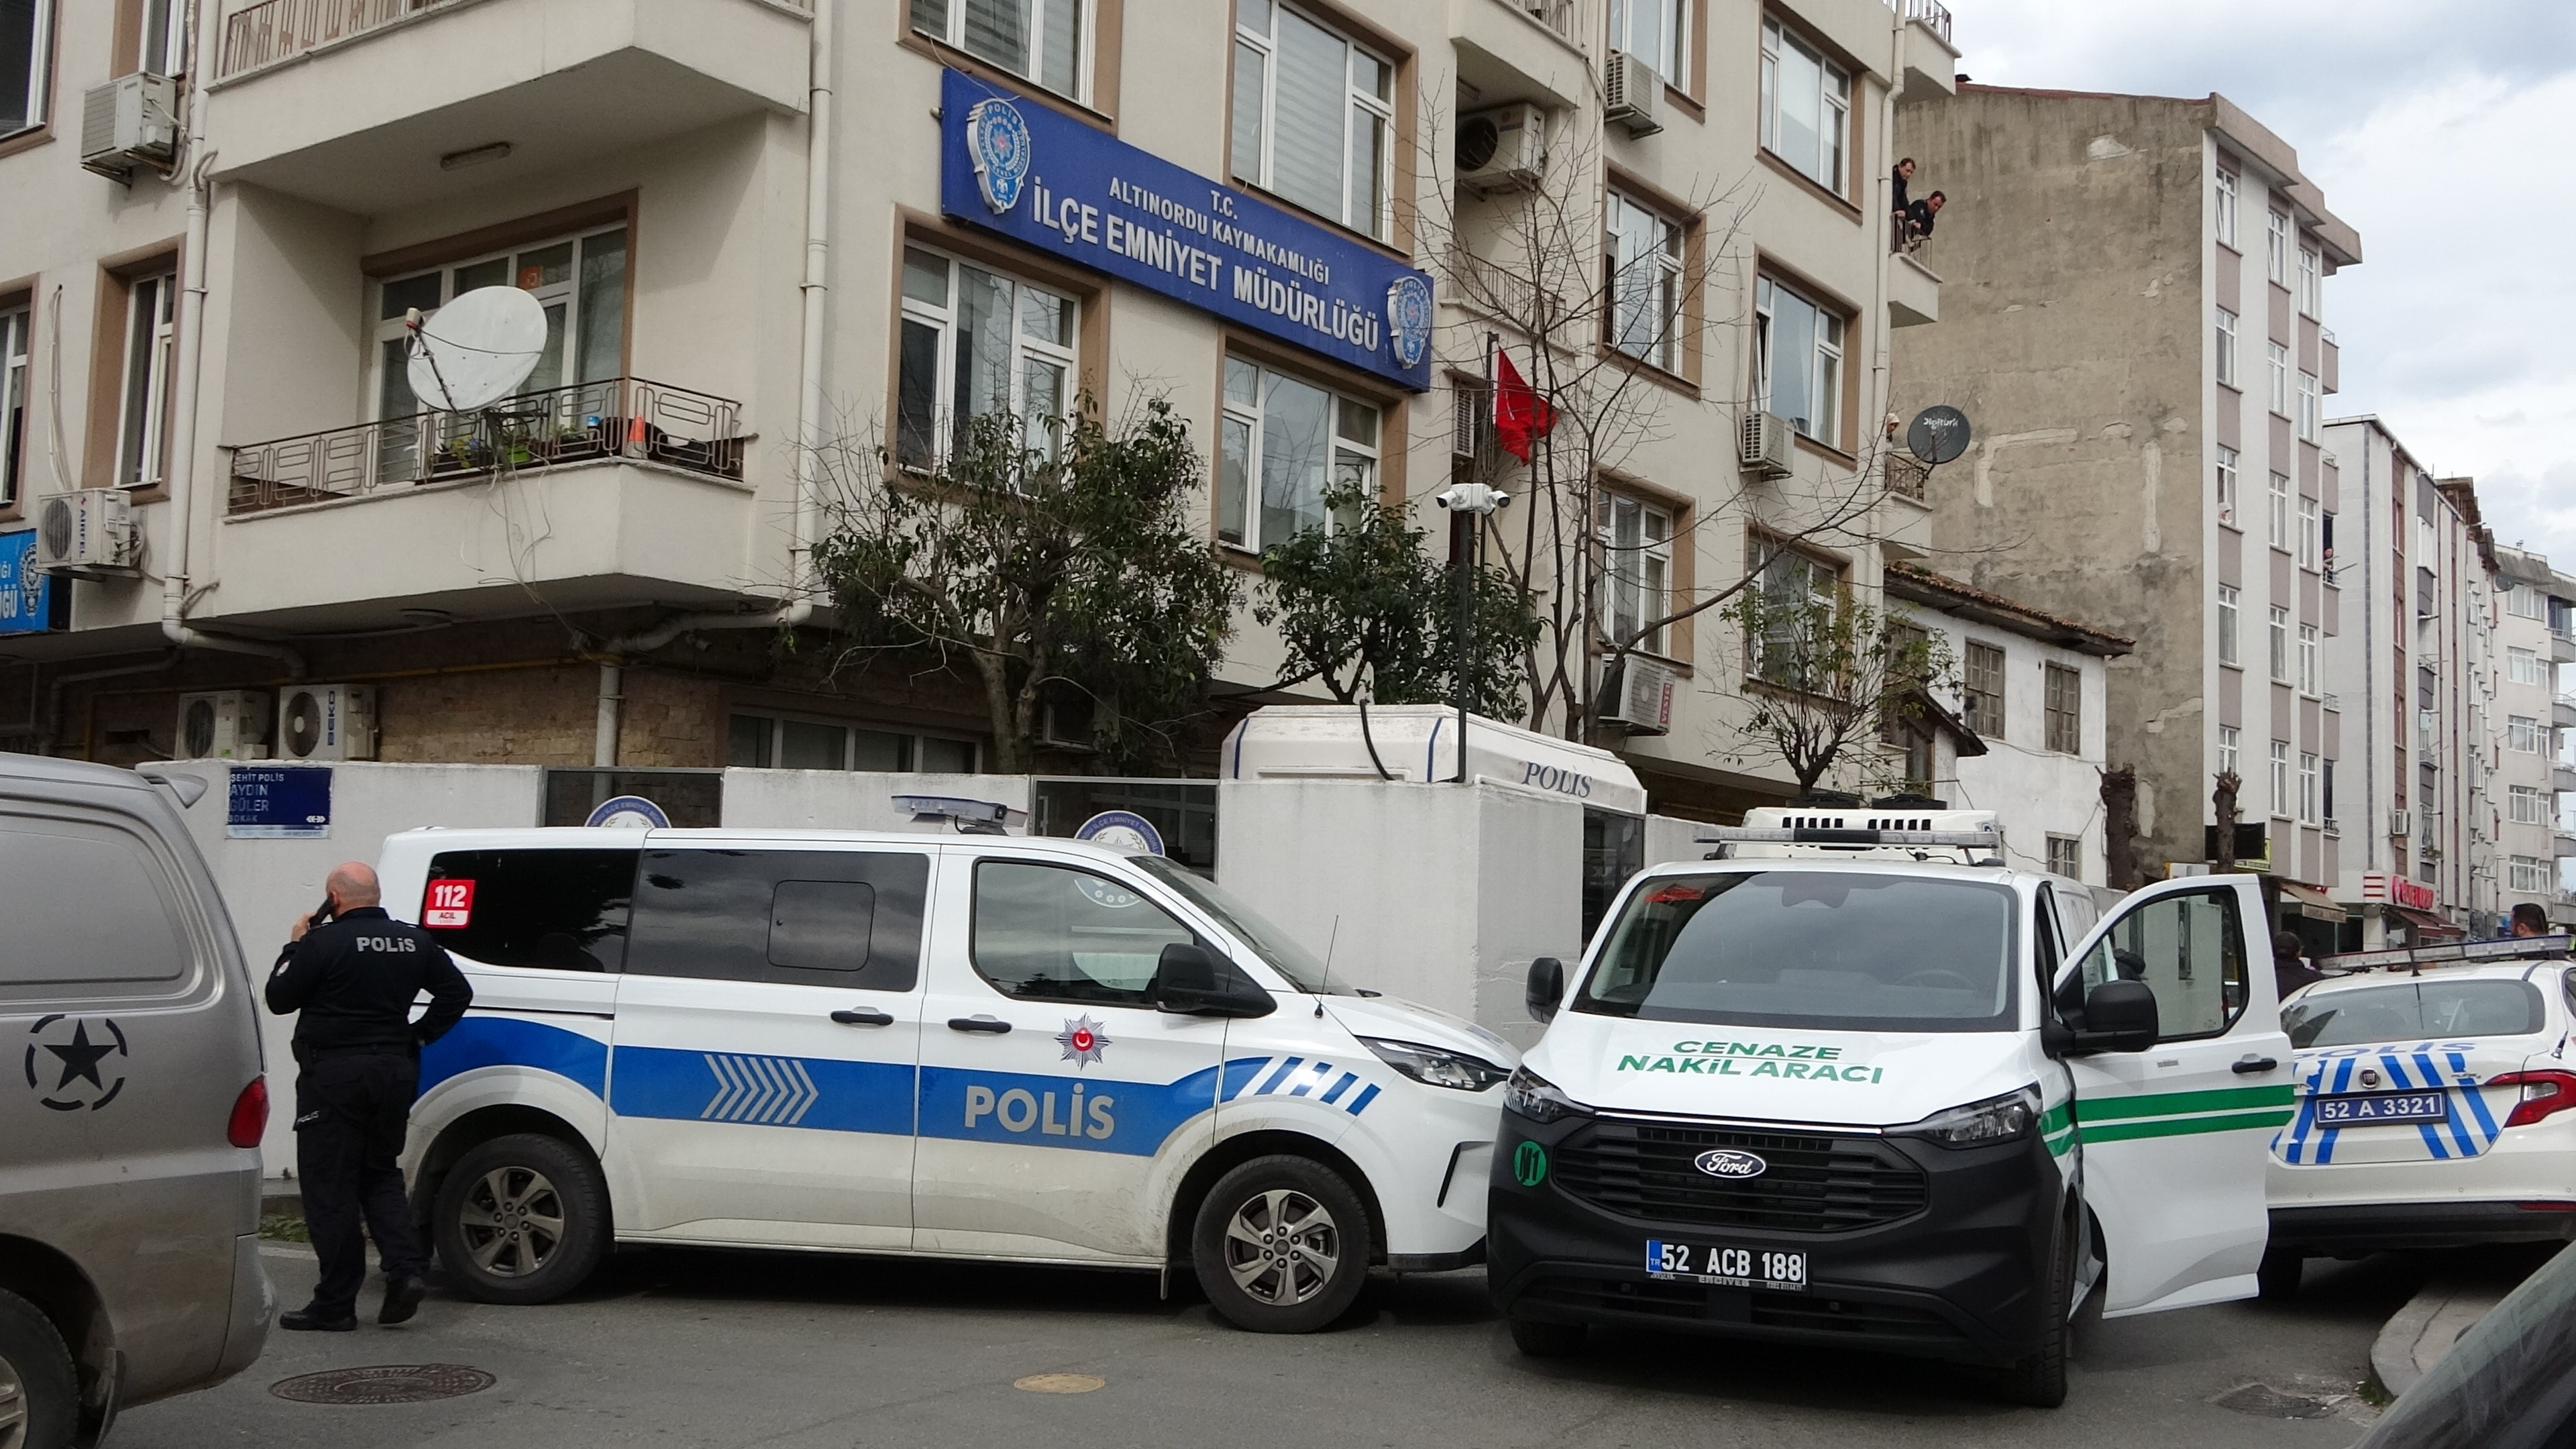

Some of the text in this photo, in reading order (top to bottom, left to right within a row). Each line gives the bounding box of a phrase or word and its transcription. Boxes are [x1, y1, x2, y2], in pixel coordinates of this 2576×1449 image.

[1210, 190, 1238, 220] T.C.
[1110, 177, 1330, 285] ALTINORDU KAYMAKAMLIĞI
[1034, 176, 1097, 244] İLÇE
[1106, 214, 1222, 291] EMNİYET
[1233, 265, 1379, 352] MÜDÜRLÜĞÜ
[231, 773, 284, 783] ŞEHİT POLİS
[435, 885, 468, 908] 112
[1673, 1040, 1843, 1060] CENAZE
[1749, 1061, 1884, 1084] ARACI
[965, 1082, 1115, 1140] POLİS
[2324, 1097, 2435, 1118] 52 A 3321
[1706, 1153, 1754, 1174] Ford
[1650, 1244, 1803, 1281] TR 52 ACB 188
